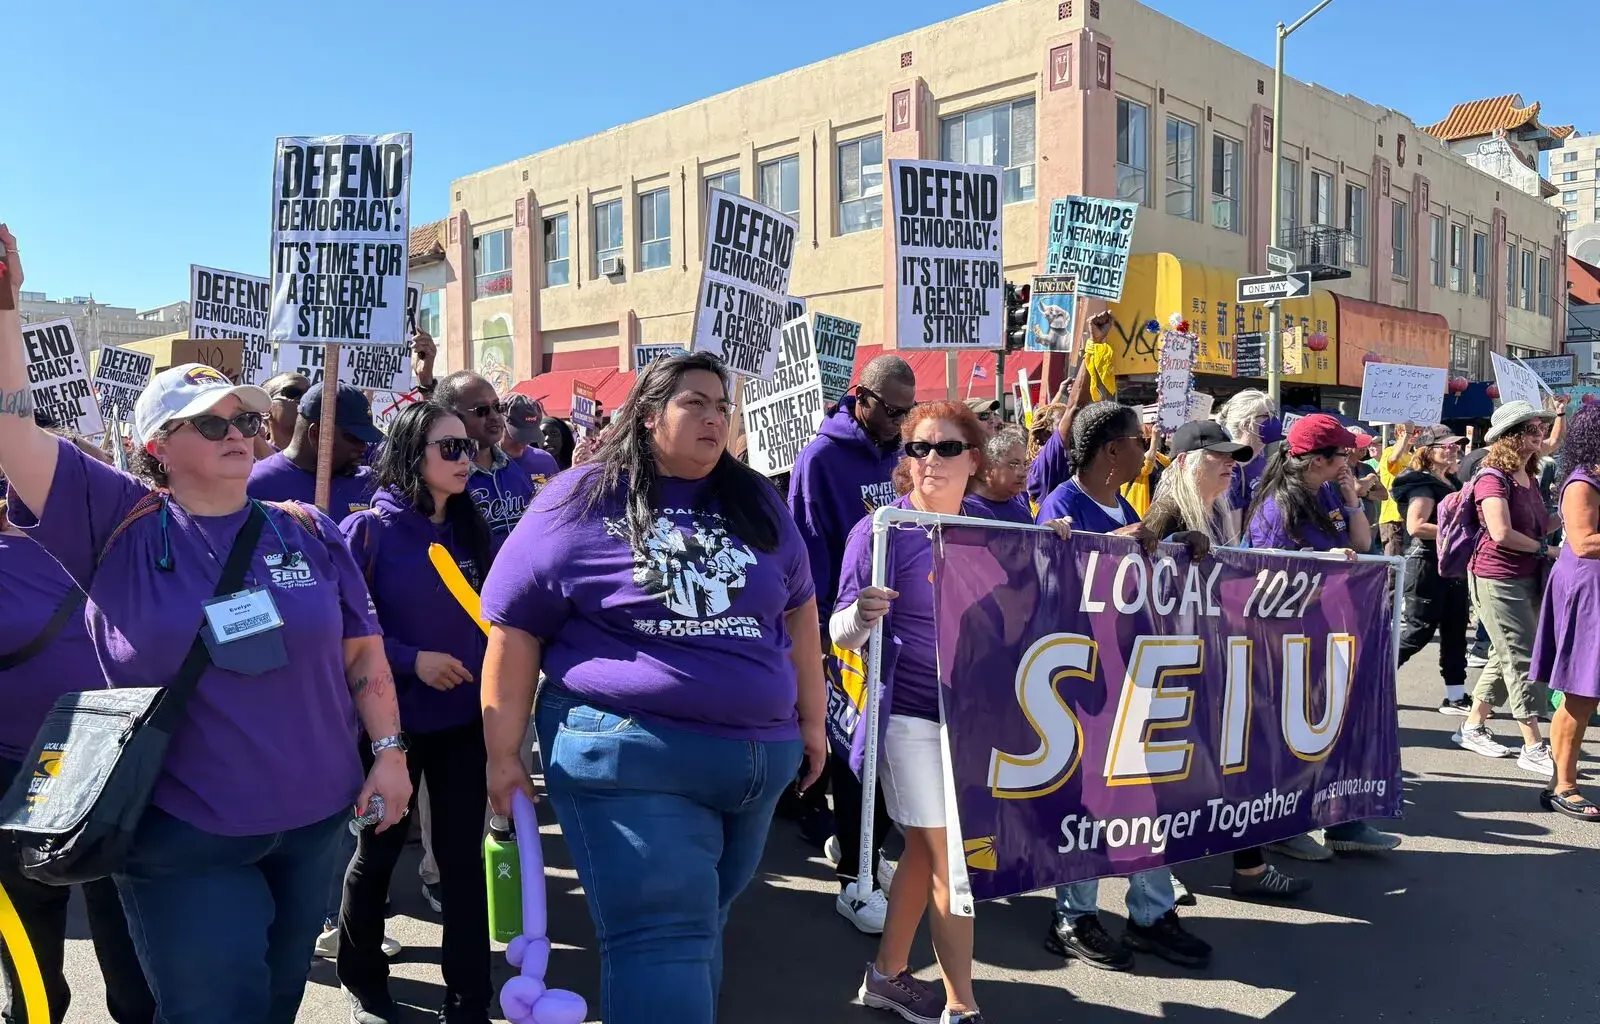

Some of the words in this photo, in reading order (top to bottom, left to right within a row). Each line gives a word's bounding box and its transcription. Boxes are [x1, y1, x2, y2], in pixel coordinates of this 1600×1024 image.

[282, 144, 403, 198] DEFEND
[899, 166, 998, 221] DEFEND
[278, 199, 401, 232] DEMOCRACY:
[1069, 200, 1120, 228] TRUMP
[1120, 208, 1133, 230] &
[715, 198, 794, 269] DEFEND
[900, 216, 998, 252] DEMOCRACY:
[278, 242, 311, 273] IT'S
[315, 242, 359, 275] TIME
[363, 244, 402, 276] FOR
[709, 243, 787, 296] DEMOCRACY:
[902, 256, 930, 286] IT'S
[934, 258, 968, 288] TIME
[972, 260, 1000, 289] FOR
[1062, 246, 1094, 263] GUILTY
[1112, 254, 1125, 269] OF
[286, 275, 298, 304] A
[302, 274, 387, 308] GENERAL
[1034, 280, 1055, 292] LYING
[1056, 279, 1074, 292] KING
[1060, 261, 1122, 288] GENOCIDE!
[1248, 284, 1266, 293] ONE
[1269, 282, 1287, 292] WAY
[197, 271, 270, 312] DEFEND
[706, 281, 736, 313] IT'S
[738, 289, 764, 322] TIME
[765, 298, 783, 330] FOR
[912, 286, 922, 314] A
[926, 286, 990, 316] GENERAL
[298, 306, 372, 339] STRIKE!
[712, 311, 723, 337] A
[725, 314, 772, 353] GENERAL
[817, 315, 832, 331] THE
[832, 319, 860, 339] PEOPLE
[923, 315, 980, 343] STRIKE!
[23, 325, 74, 363] END
[720, 339, 766, 375] STRIKE!
[815, 330, 856, 360] UNITED
[97, 366, 146, 387] DEMOCRACY:
[101, 348, 151, 375] DEFEND
[347, 351, 355, 367] A
[357, 351, 403, 374] GENERAL
[60, 379, 90, 402] FOR
[112, 385, 130, 399] TIME
[352, 369, 395, 389] STRIKE!
[744, 362, 816, 405] DEMOCRACY:
[576, 396, 593, 415] NOT
[748, 406, 769, 433] IT'S
[768, 396, 798, 425] TIME
[798, 388, 821, 418] FOR
[759, 429, 766, 452] A
[767, 414, 817, 448] GENERAL
[272, 570, 311, 583] SEIU
[1079, 550, 1223, 616] LOCAL
[1243, 569, 1322, 618] 1021
[658, 626, 762, 638] TOGETHER
[659, 617, 759, 631] STRONGER
[986, 632, 1355, 798] SEIU
[1313, 778, 1386, 805] www.SEIU1021.org
[1058, 808, 1201, 854] Stronger
[1207, 788, 1302, 838] Together
